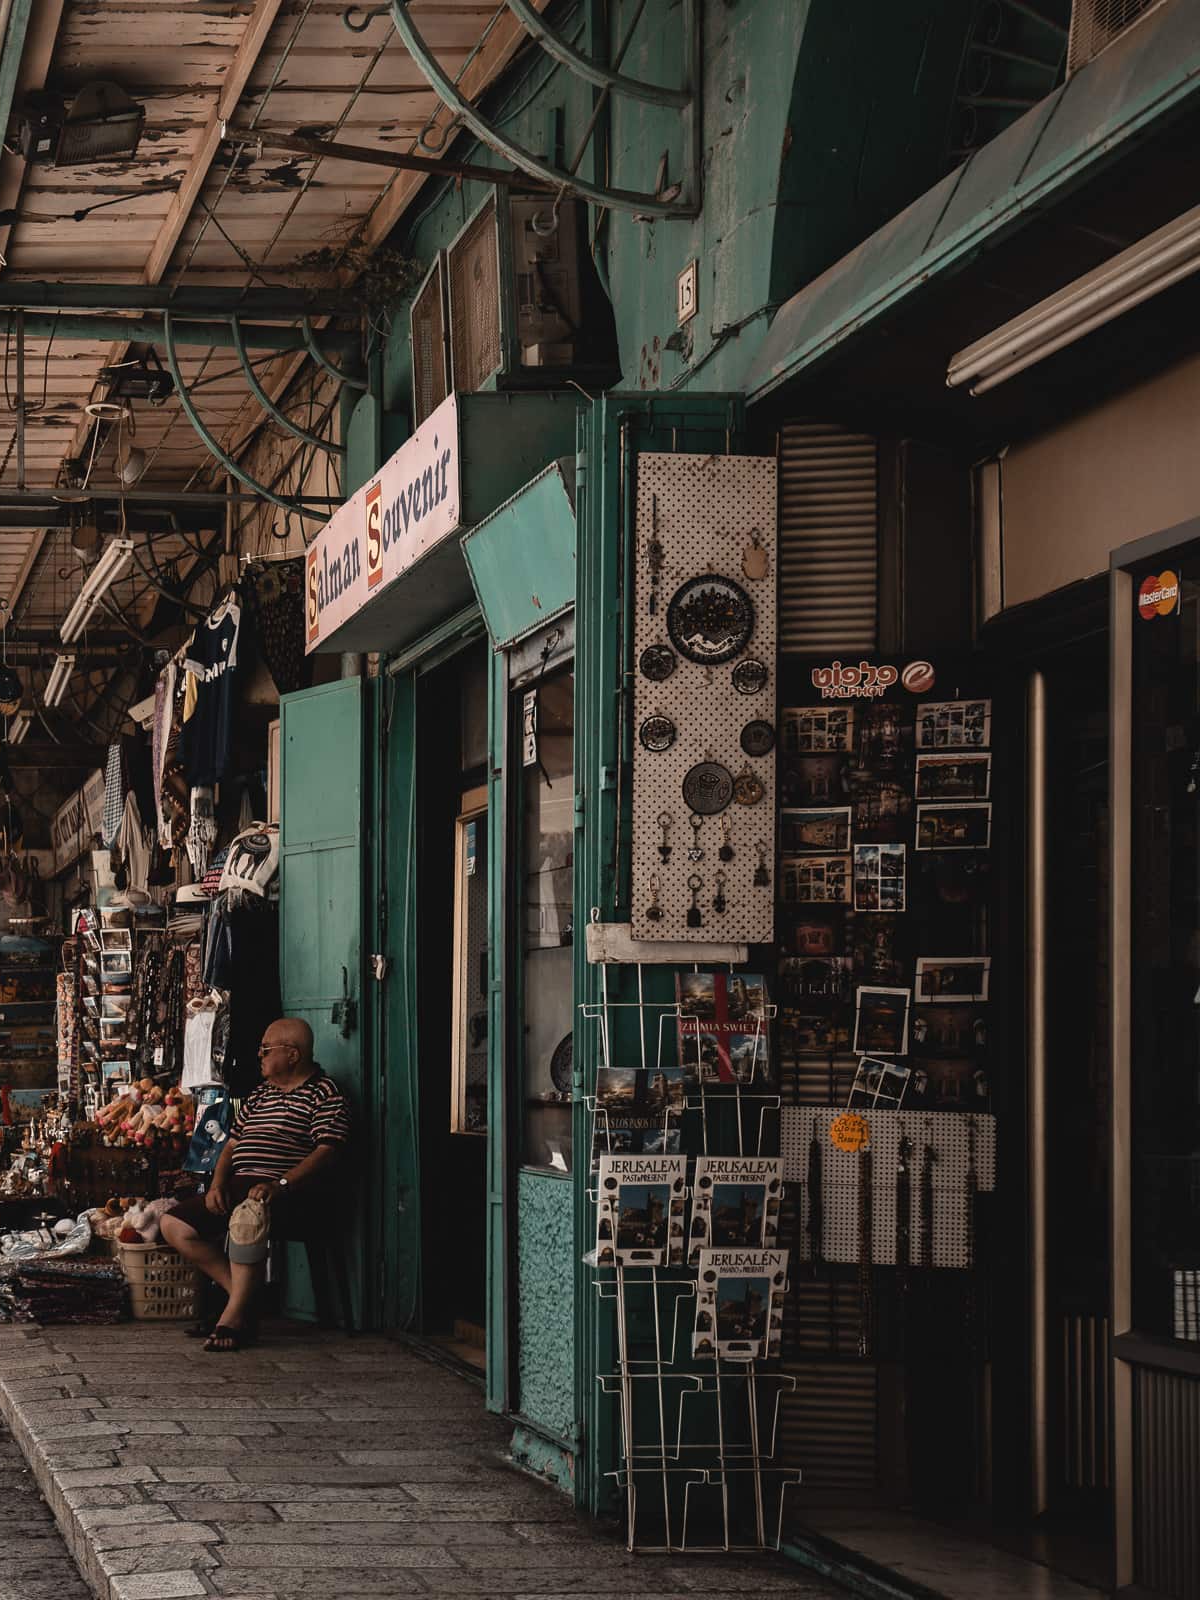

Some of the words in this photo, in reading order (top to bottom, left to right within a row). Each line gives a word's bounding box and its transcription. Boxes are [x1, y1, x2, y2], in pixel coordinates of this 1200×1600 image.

[681, 278, 691, 309] 15
[308, 536, 361, 624] Salman
[367, 433, 451, 570] Souvenir
[1138, 584, 1178, 607] MasterCard
[822, 685, 886, 698] PALPHOT
[608, 1160, 680, 1173] JERUSALEM
[704, 1161, 777, 1173] JERUSALEM
[708, 1251, 781, 1265] JERUSALÉN
